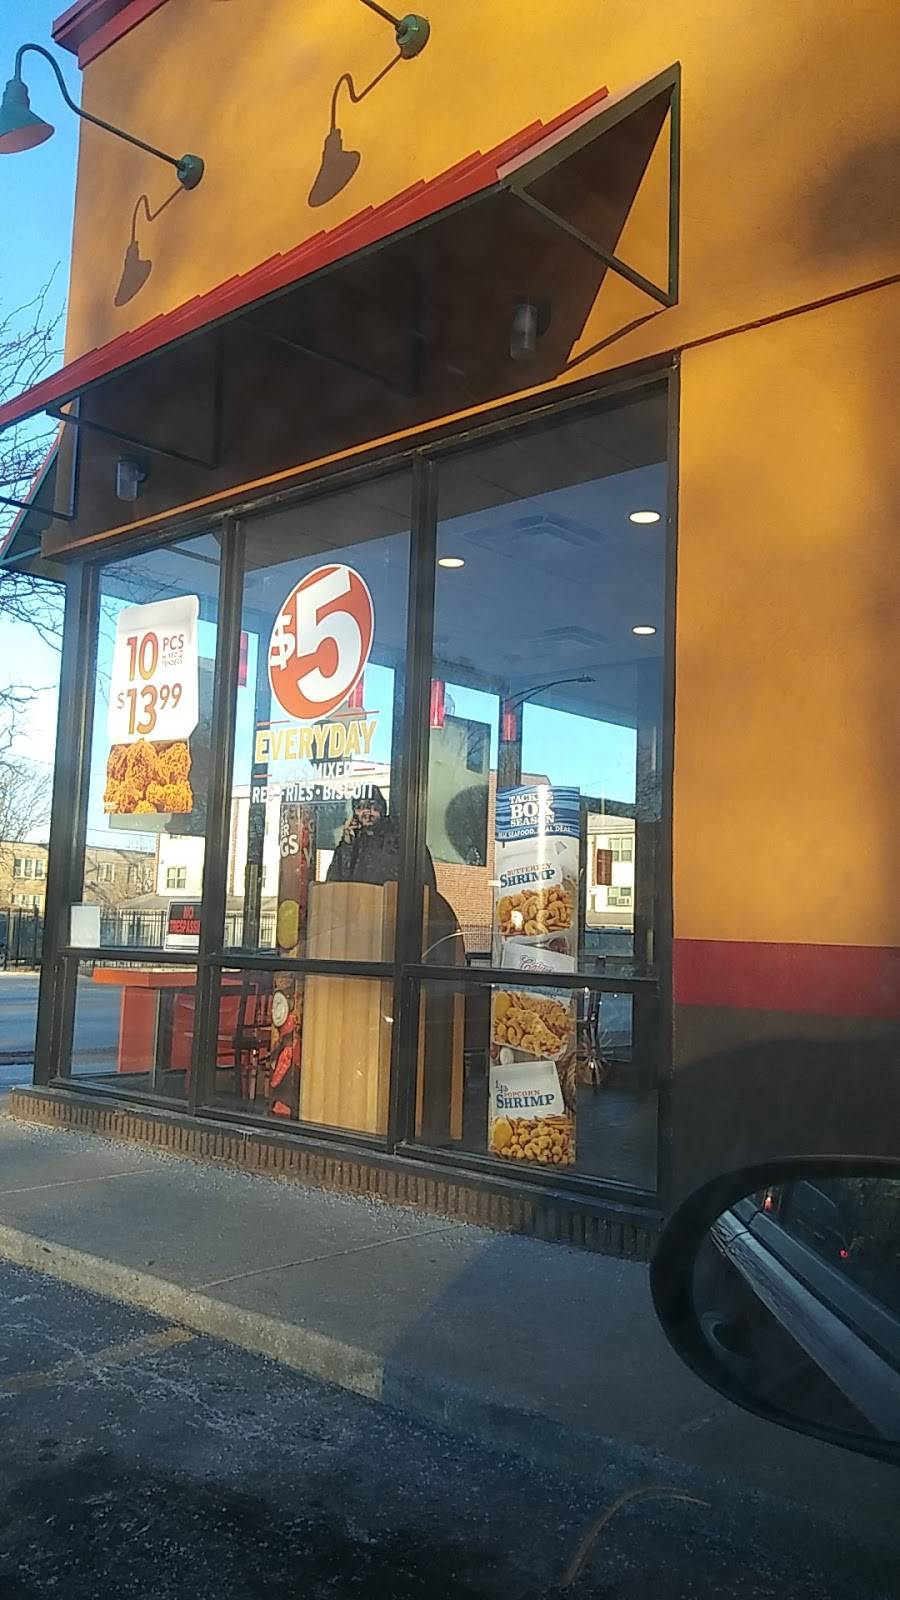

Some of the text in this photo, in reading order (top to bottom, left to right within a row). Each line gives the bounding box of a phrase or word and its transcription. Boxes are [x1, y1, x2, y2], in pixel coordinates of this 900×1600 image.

[269, 567, 362, 703] $5
[126, 631, 185, 681] 10 PCS
[254, 720, 378, 764] EVERYDAY
[280, 783, 315, 801] FRIES
[508, 790, 554, 804] TACKE
[510, 800, 555, 820] BOX
[510, 815, 555, 828] SEASN
[500, 869, 555, 888] SHRIMP
[183, 905, 194, 919] NO
[496, 1094, 555, 1109] SHRIMP
[503, 1089, 541, 1098] POPCORN
